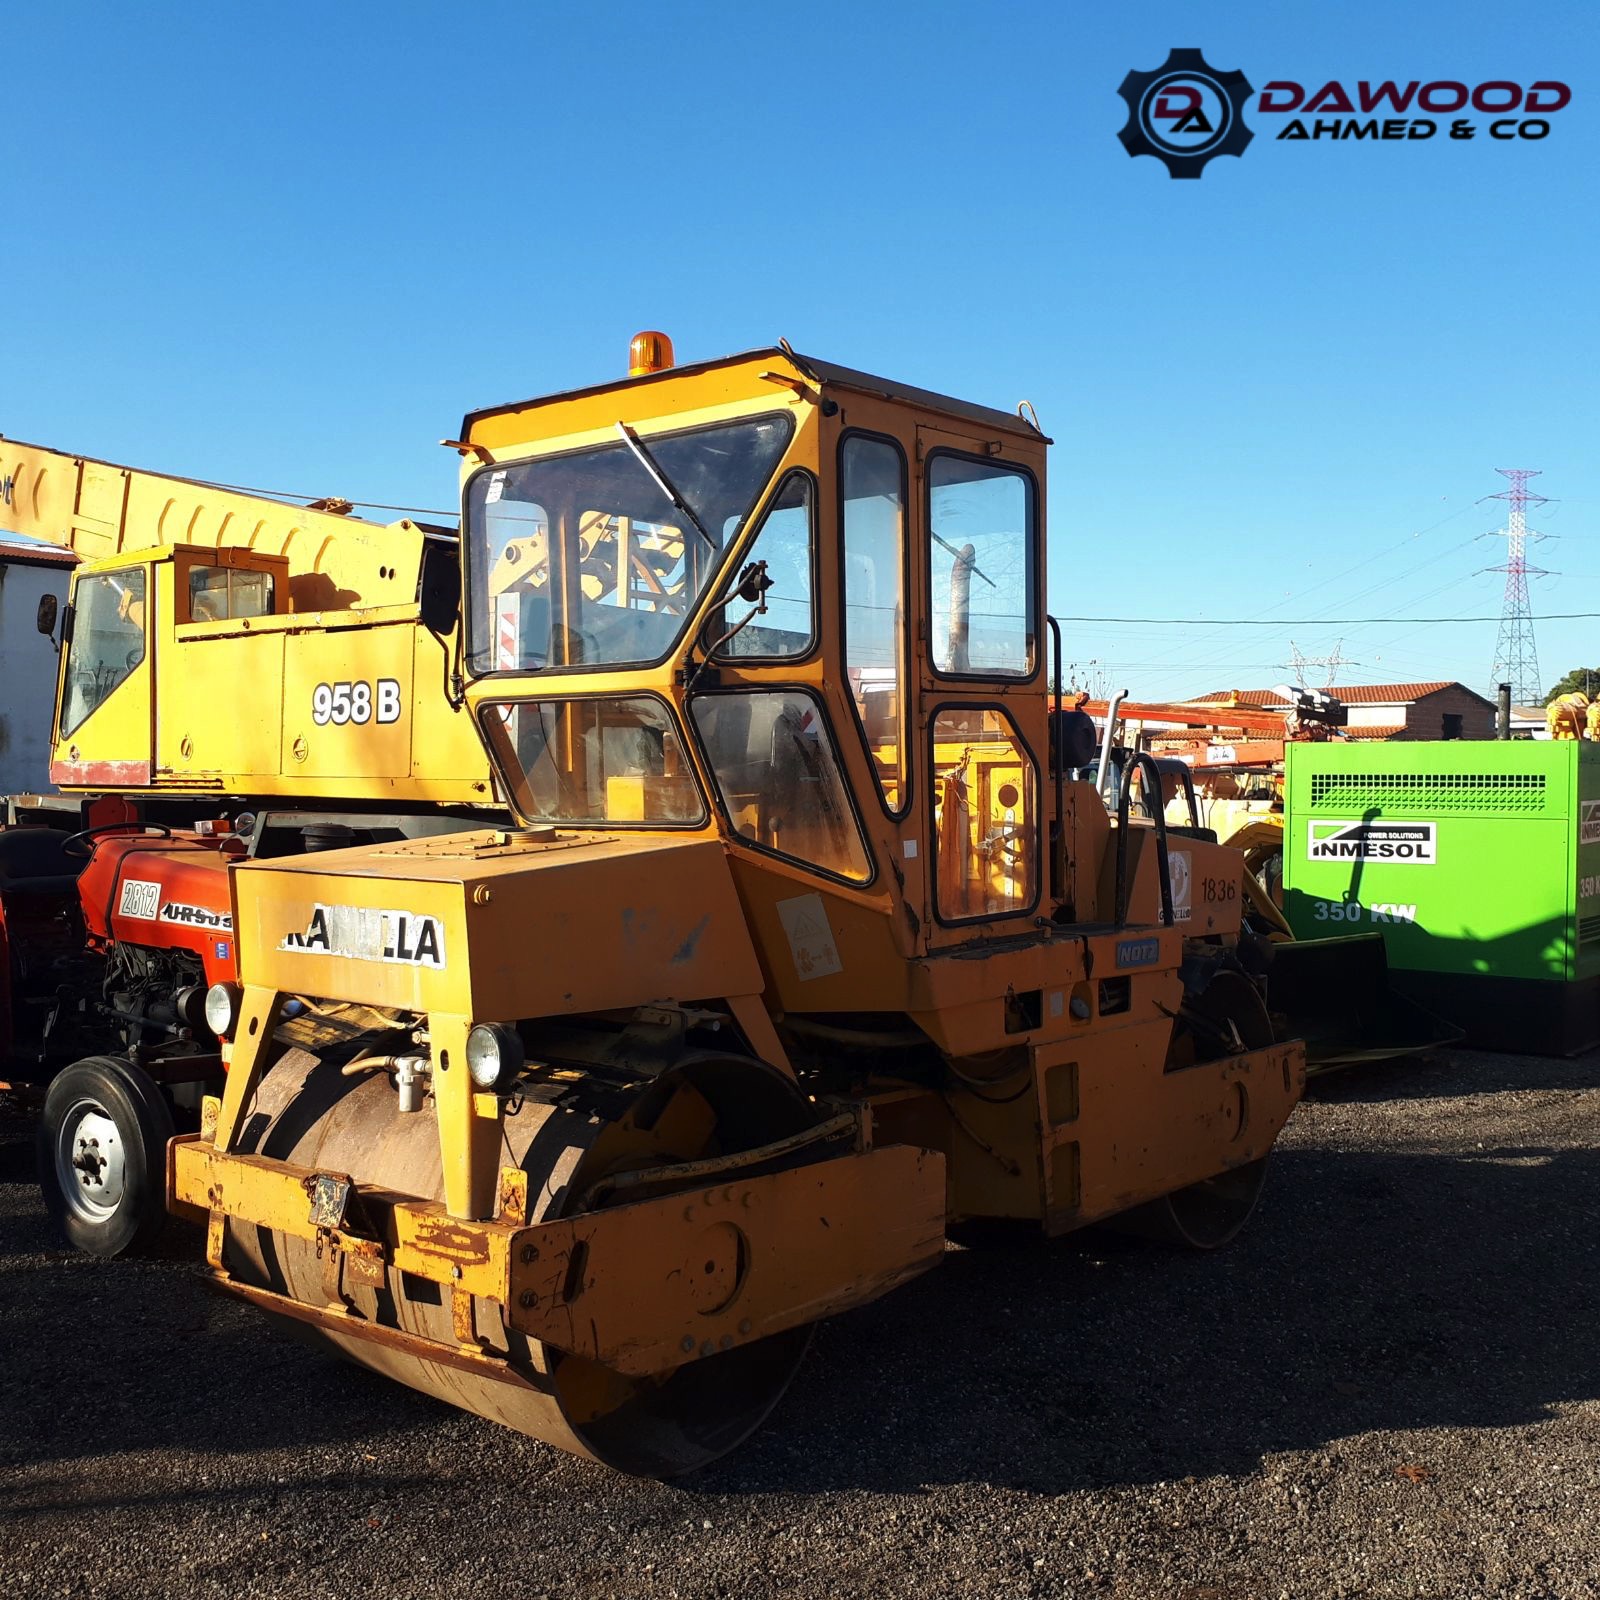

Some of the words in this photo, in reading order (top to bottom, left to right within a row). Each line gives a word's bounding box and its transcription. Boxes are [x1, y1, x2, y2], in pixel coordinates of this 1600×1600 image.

[312, 680, 372, 726] 958
[376, 678, 401, 724] B
[1364, 832, 1388, 840] POWER
[1388, 832, 1424, 840] SOLUTIONS
[1312, 843, 1431, 859] INMESOL
[122, 882, 158, 918] 2812
[1201, 877, 1237, 904] 1836
[1313, 901, 1361, 922] 350
[1370, 903, 1418, 924] KW
